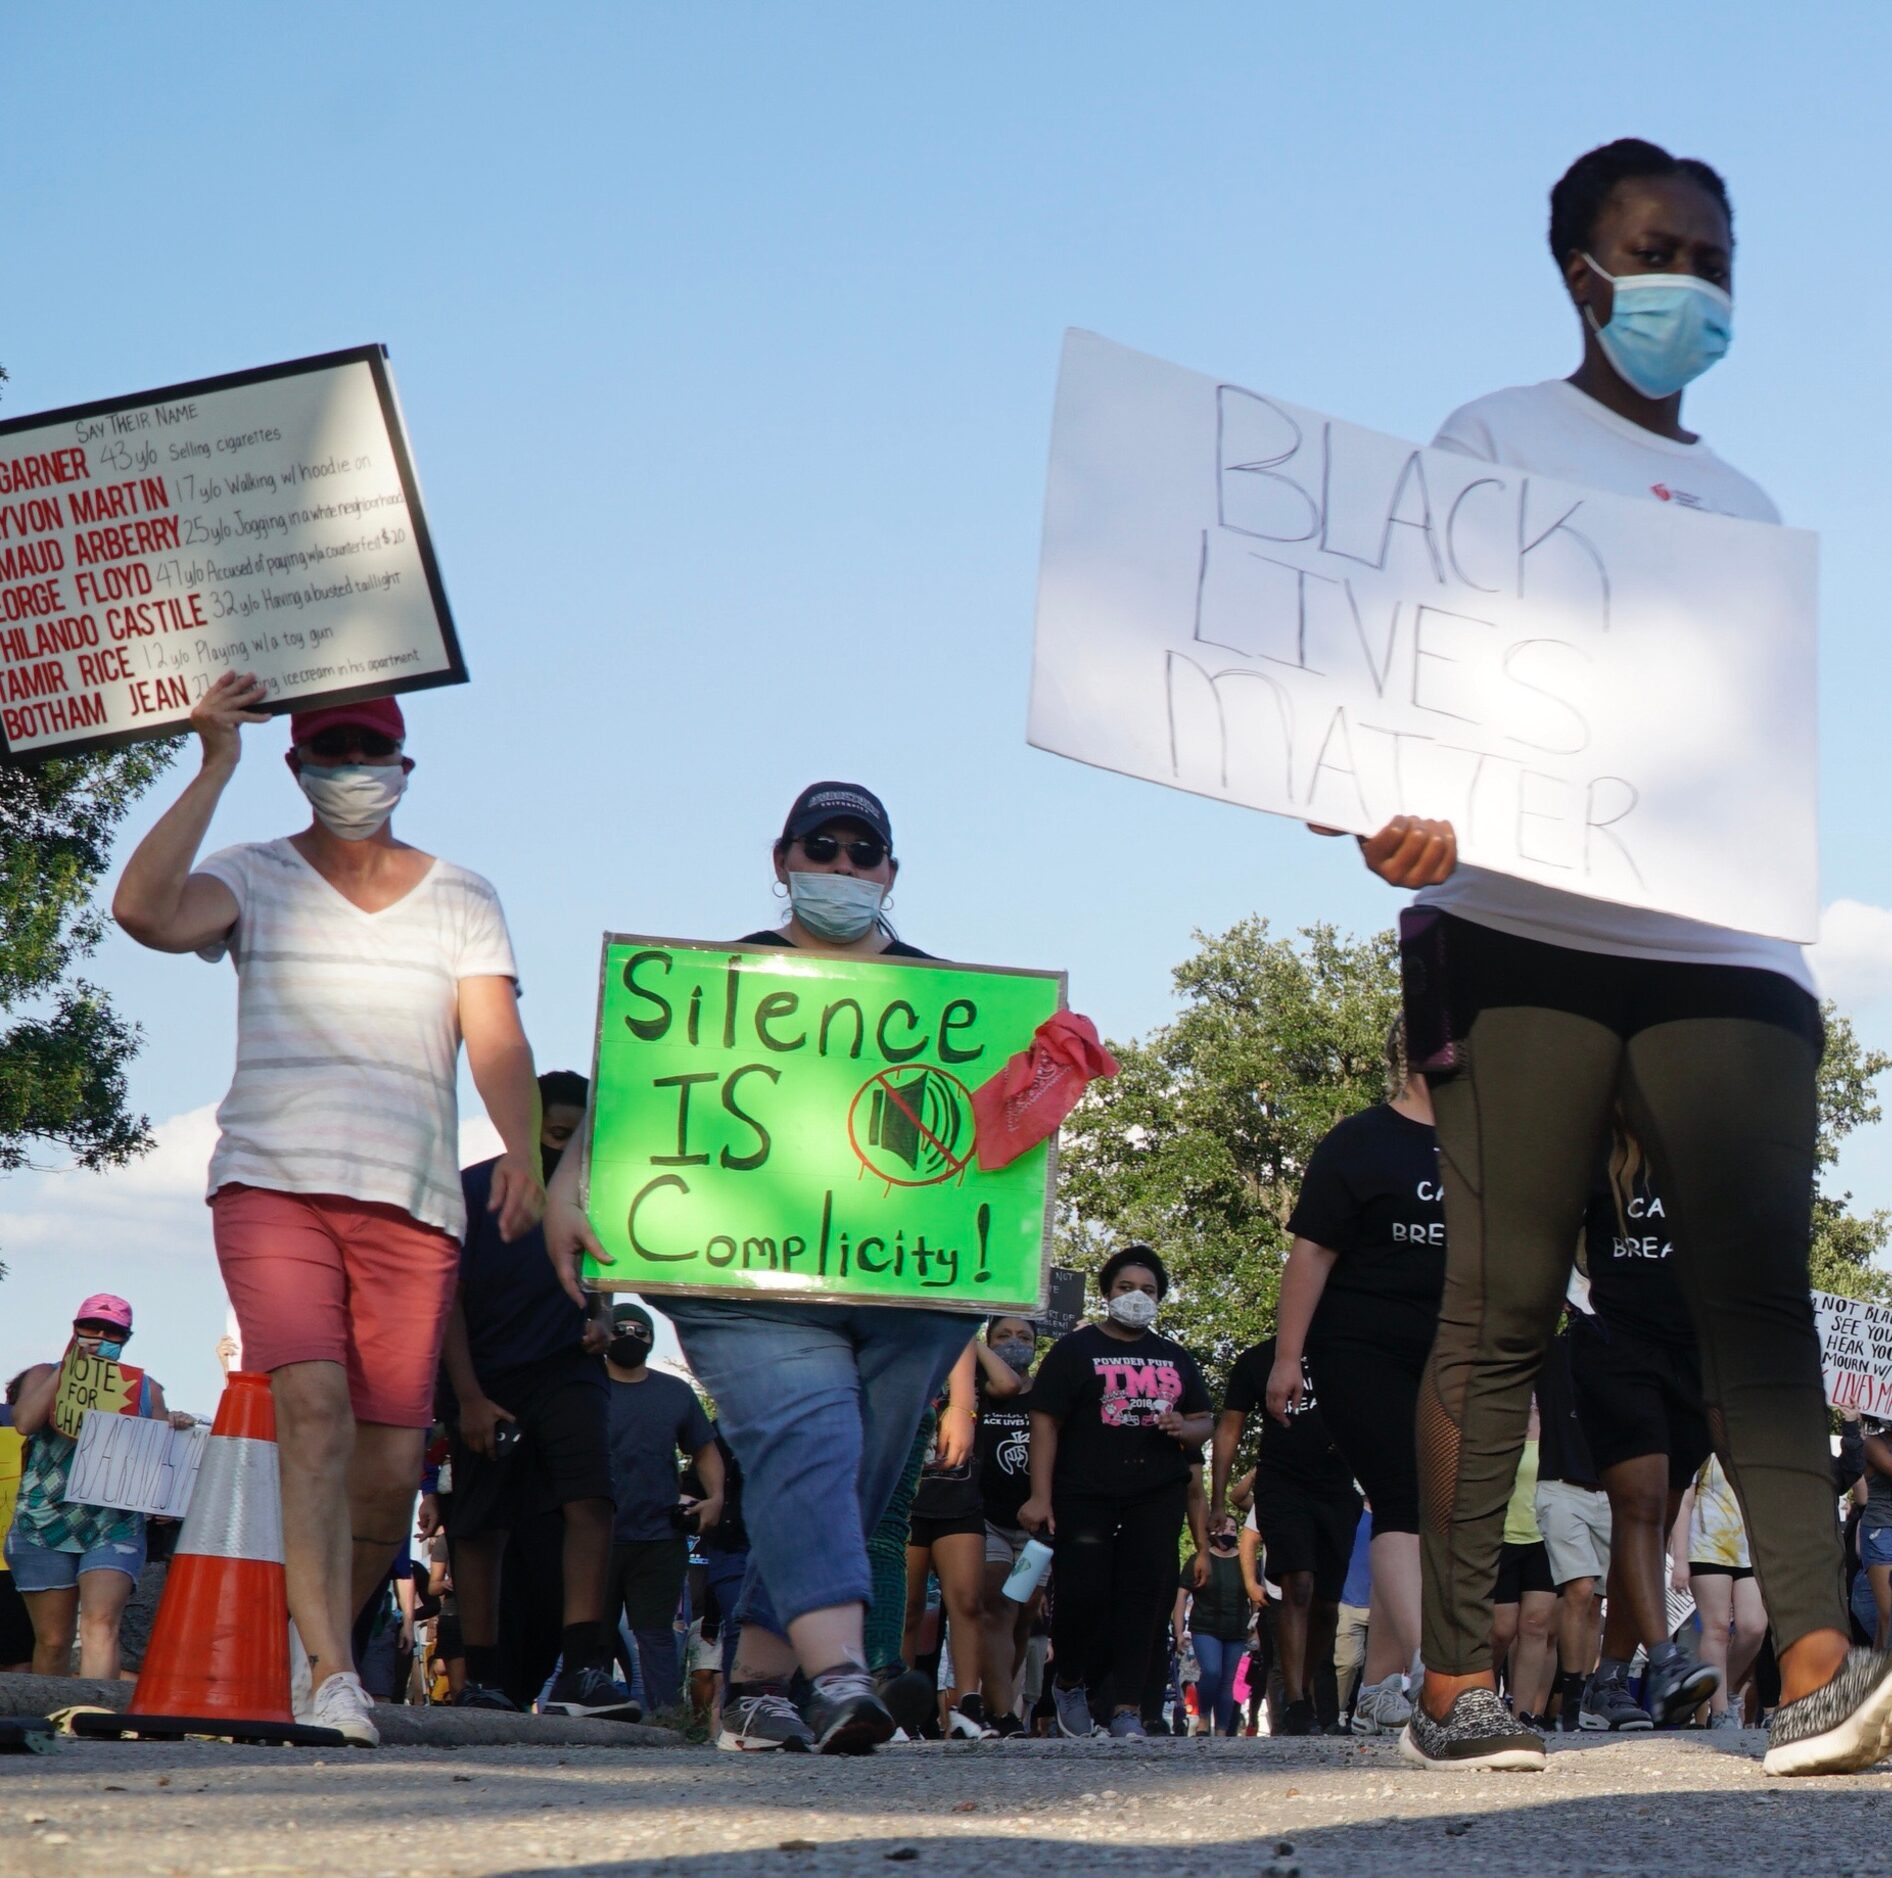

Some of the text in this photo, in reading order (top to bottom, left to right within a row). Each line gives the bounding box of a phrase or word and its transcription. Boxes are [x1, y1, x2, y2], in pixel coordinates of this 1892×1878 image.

[75, 403, 198, 444] SAY THEIR NAME
[100, 440, 132, 471] 43
[169, 440, 211, 462] Selling
[217, 427, 282, 452] cigarettes
[0, 496, 64, 540] YVON
[68, 475, 170, 526] MARTIN
[175, 474, 194, 503] 17
[227, 474, 277, 496] Walking
[299, 456, 350, 481] hoodie
[355, 454, 372, 471] on
[1216, 383, 1610, 632] BLACK
[75, 514, 181, 566] ARBERRY
[183, 516, 210, 546] 25
[233, 509, 288, 541] Jogging
[74, 562, 153, 607] FLOYD
[156, 559, 183, 588] 47
[207, 555, 253, 582] Accused
[266, 551, 309, 576] paying
[106, 593, 208, 641] CASTILE
[210, 590, 238, 618] 32
[262, 588, 303, 610] Having
[312, 574, 353, 601] busted
[78, 646, 135, 687] RICE
[143, 642, 167, 669] 12
[194, 639, 249, 666] Playing
[283, 631, 304, 649] toy
[309, 626, 334, 648] gun
[1194, 529, 1595, 758] LIVES
[3, 692, 108, 742] BOTHAM
[129, 675, 191, 717] JEAN
[367, 650, 421, 671] apartment
[1164, 648, 1648, 892] MATTER
[622, 950, 987, 1063] Silence
[650, 1062, 783, 1171] IS
[1822, 1296, 1860, 1316] NOT
[1831, 1315, 1861, 1336] SEE
[69, 1345, 118, 1392] VOTE
[1092, 1357, 1146, 1367] POWDER
[1822, 1351, 1870, 1373] MOURN
[1874, 1363, 1892, 1381] W/
[1826, 1334, 1864, 1356] HEAR
[68, 1382, 98, 1410] FOR
[1094, 1364, 1182, 1401] TMS
[1832, 1370, 1874, 1412] LIVES
